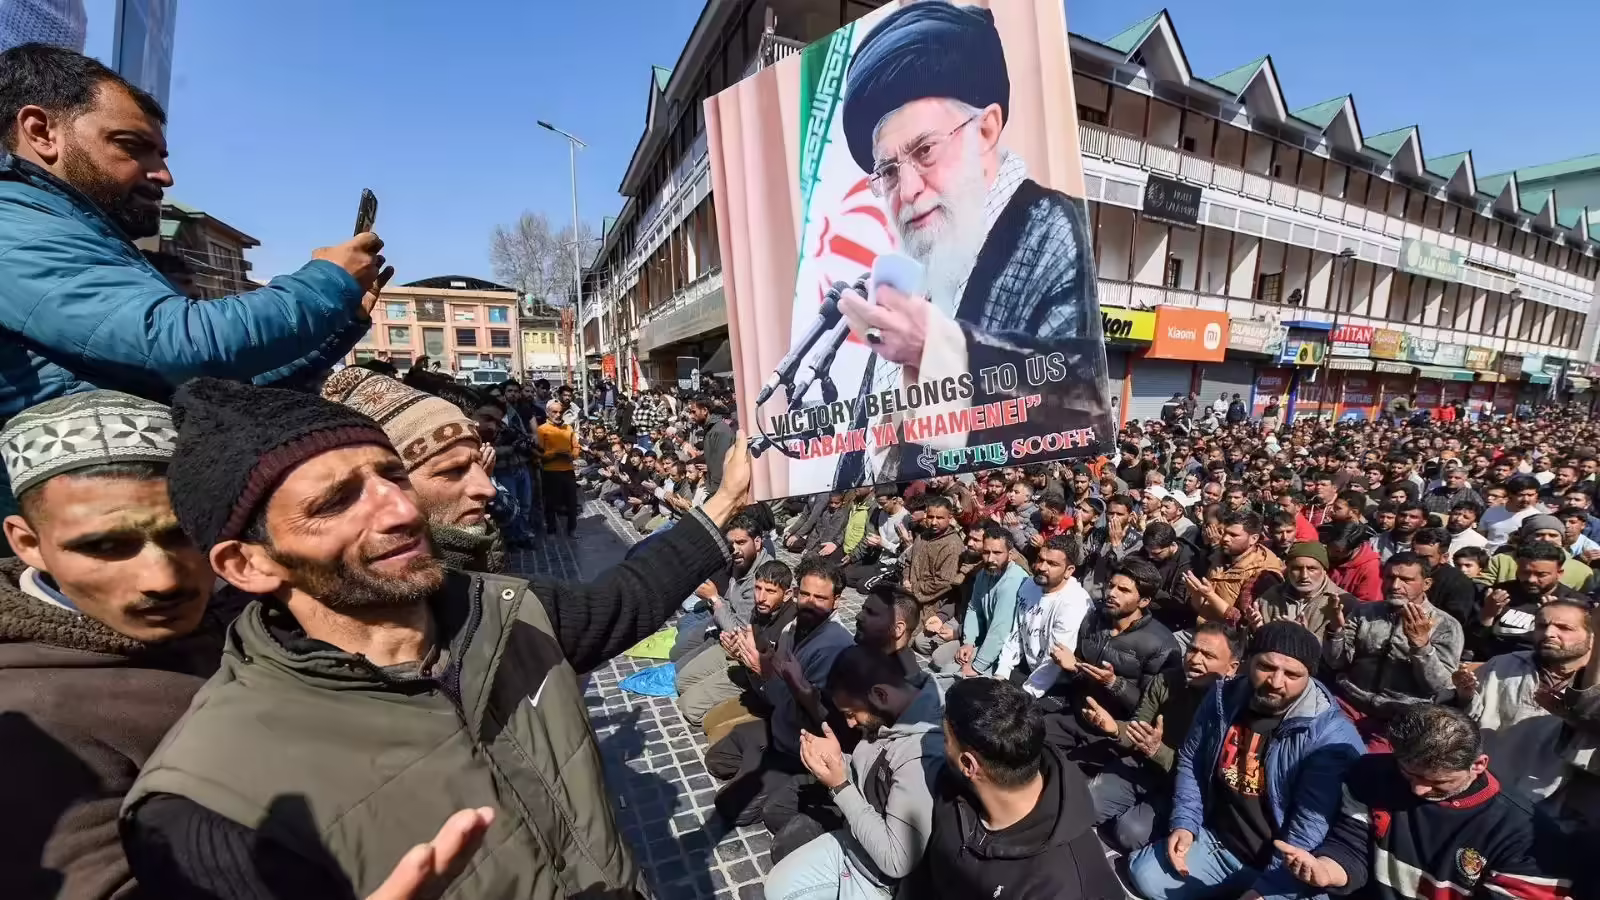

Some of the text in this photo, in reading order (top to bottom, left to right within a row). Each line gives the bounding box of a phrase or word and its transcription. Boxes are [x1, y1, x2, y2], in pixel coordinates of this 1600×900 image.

[1101, 311, 1133, 337] kon
[1167, 326, 1197, 341] Xiaomi
[1337, 326, 1373, 342] TITAN
[771, 352, 1067, 437] VICTORY BELONGS TO US
[871, 423, 898, 449] YA
[936, 427, 1096, 471] LITTLE SCOFF
[1500, 608, 1536, 629] NIK
